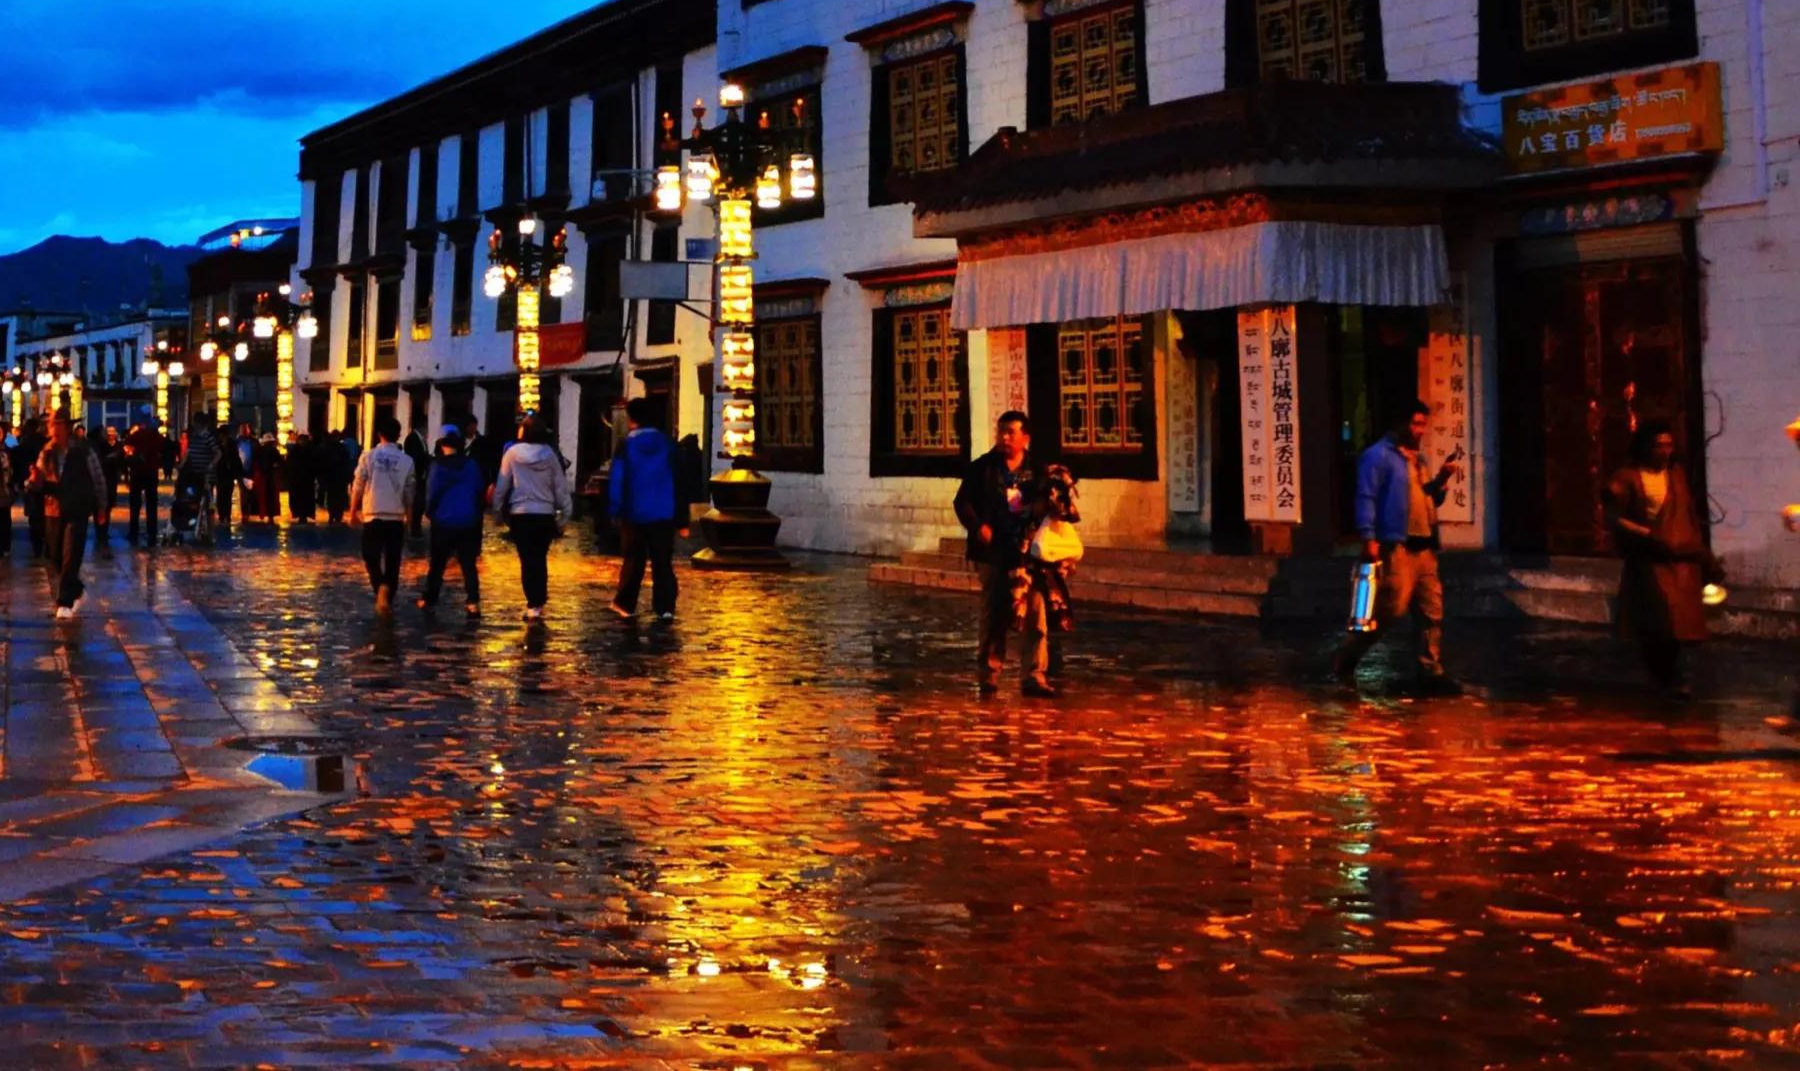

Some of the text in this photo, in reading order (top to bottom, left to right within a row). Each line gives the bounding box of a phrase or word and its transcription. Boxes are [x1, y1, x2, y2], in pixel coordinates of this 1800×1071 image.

[1518, 119, 1628, 156] 八宝百货店
